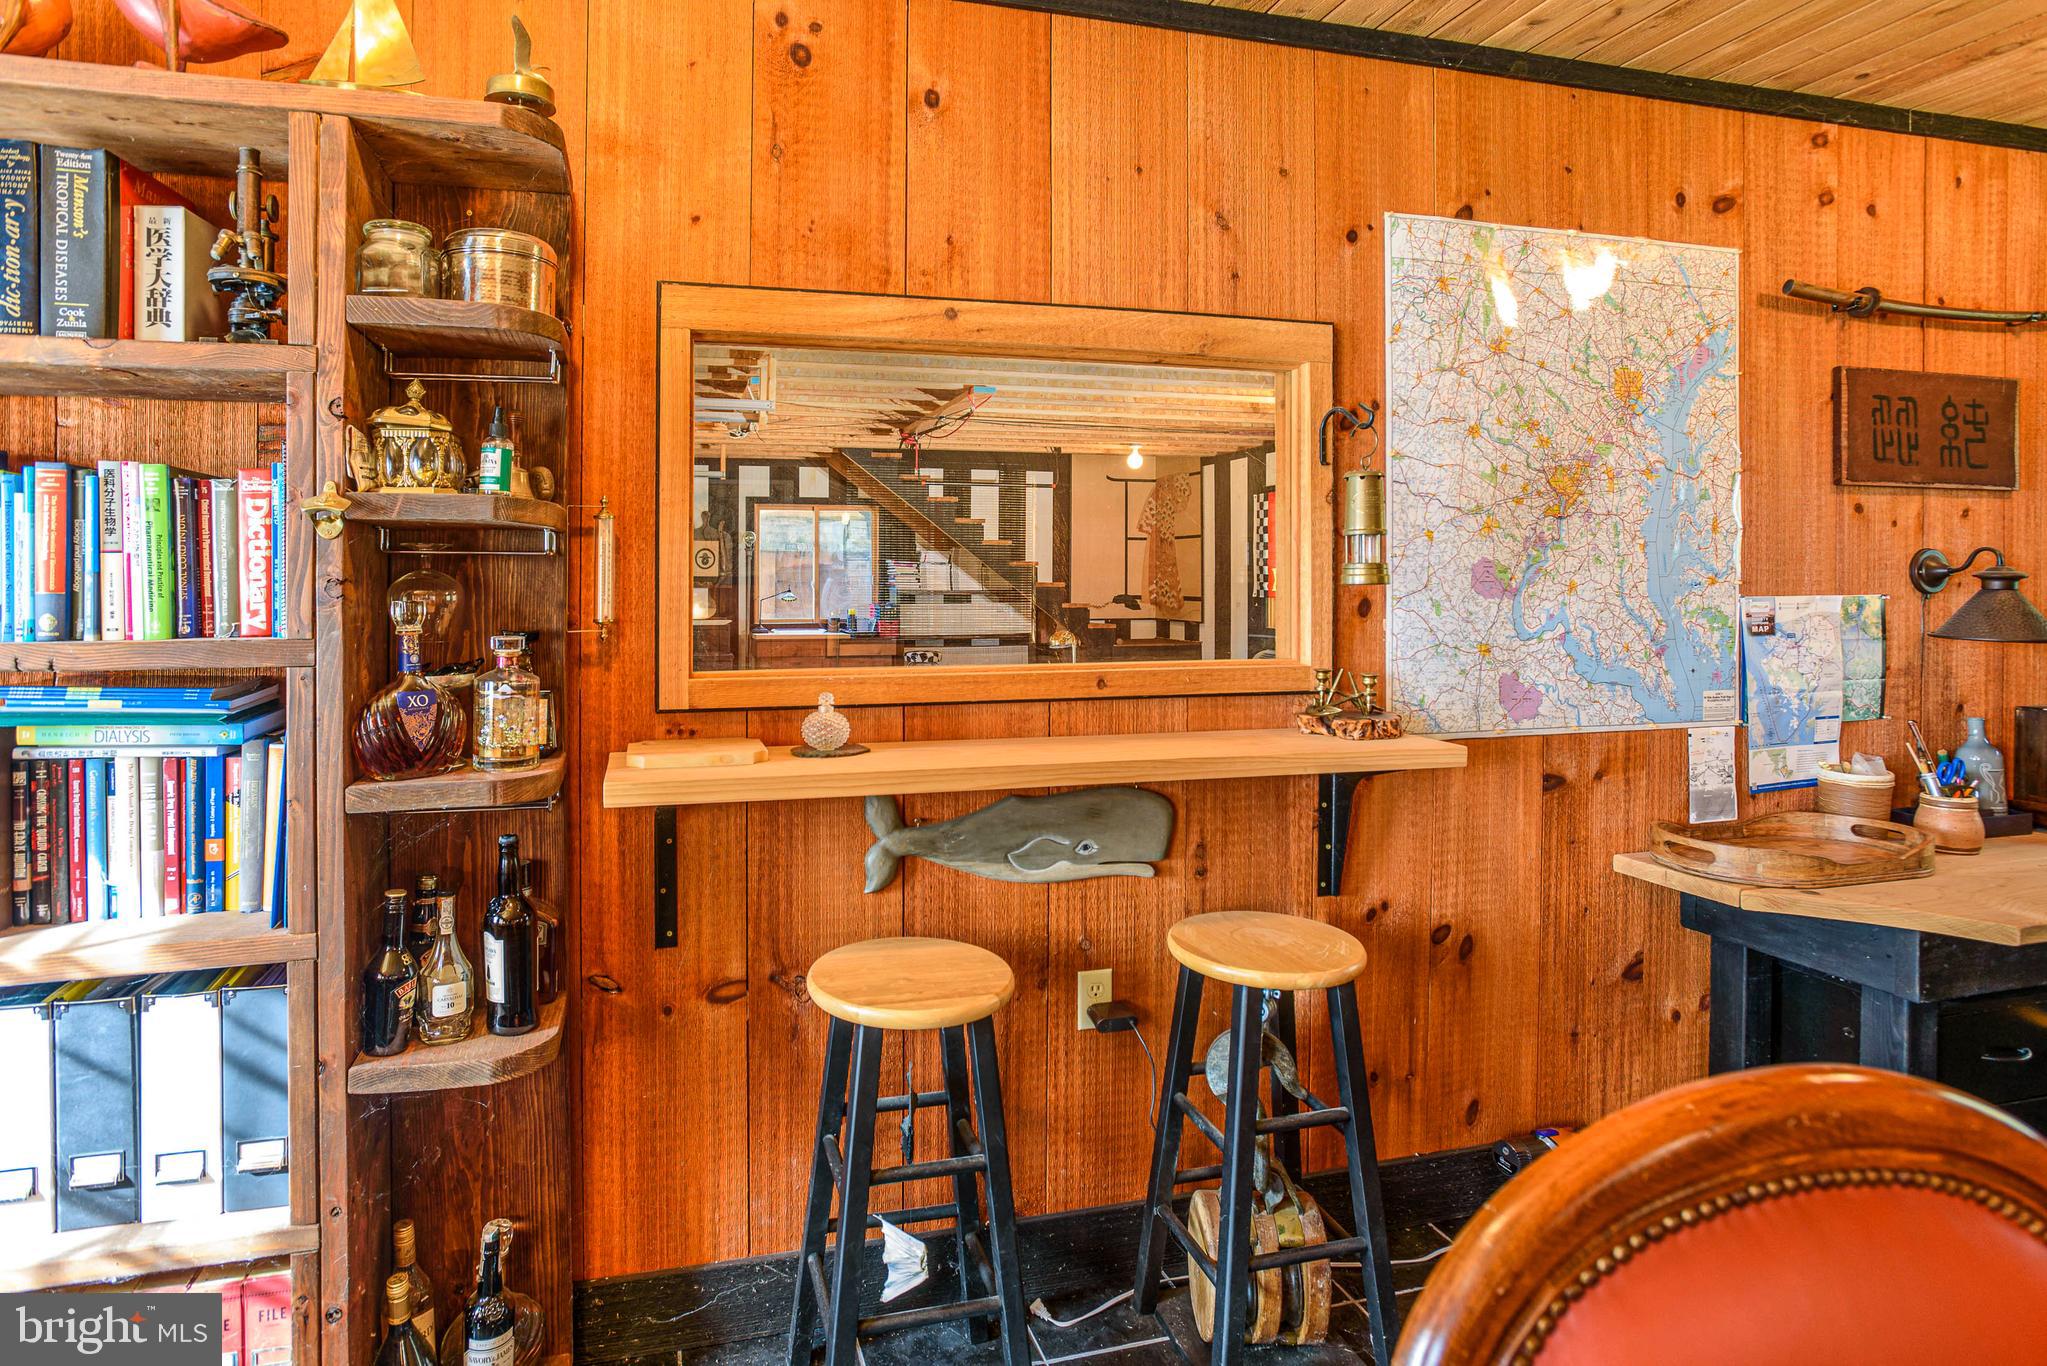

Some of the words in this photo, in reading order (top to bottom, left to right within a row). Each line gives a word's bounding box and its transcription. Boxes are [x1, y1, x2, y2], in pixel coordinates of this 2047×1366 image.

[54, 150, 92, 160] Twenty-first
[56, 158, 91, 170] Edition
[56, 173, 69, 238] TROPICAL
[72, 173, 90, 239] Manson's
[55, 238, 68, 301] DISEASES
[145, 226, 172, 328] 医学大辞典
[56, 318, 87, 328] Zumla
[59, 307, 86, 317] Cook
[104, 468, 116, 536] 医科分子生物学
[73, 519, 82, 543] biology
[74, 545, 82, 557] and
[145, 520, 154, 576] Pharmaceutical
[245, 498, 270, 630] Dictionary
[73, 558, 81, 592] pathology
[147, 580, 155, 612] Medicine
[407, 695, 428, 708] XO
[94, 730, 150, 743] DIALYSIS
[89, 770, 98, 809] Generation
[258, 1306, 287, 1322] FILE
